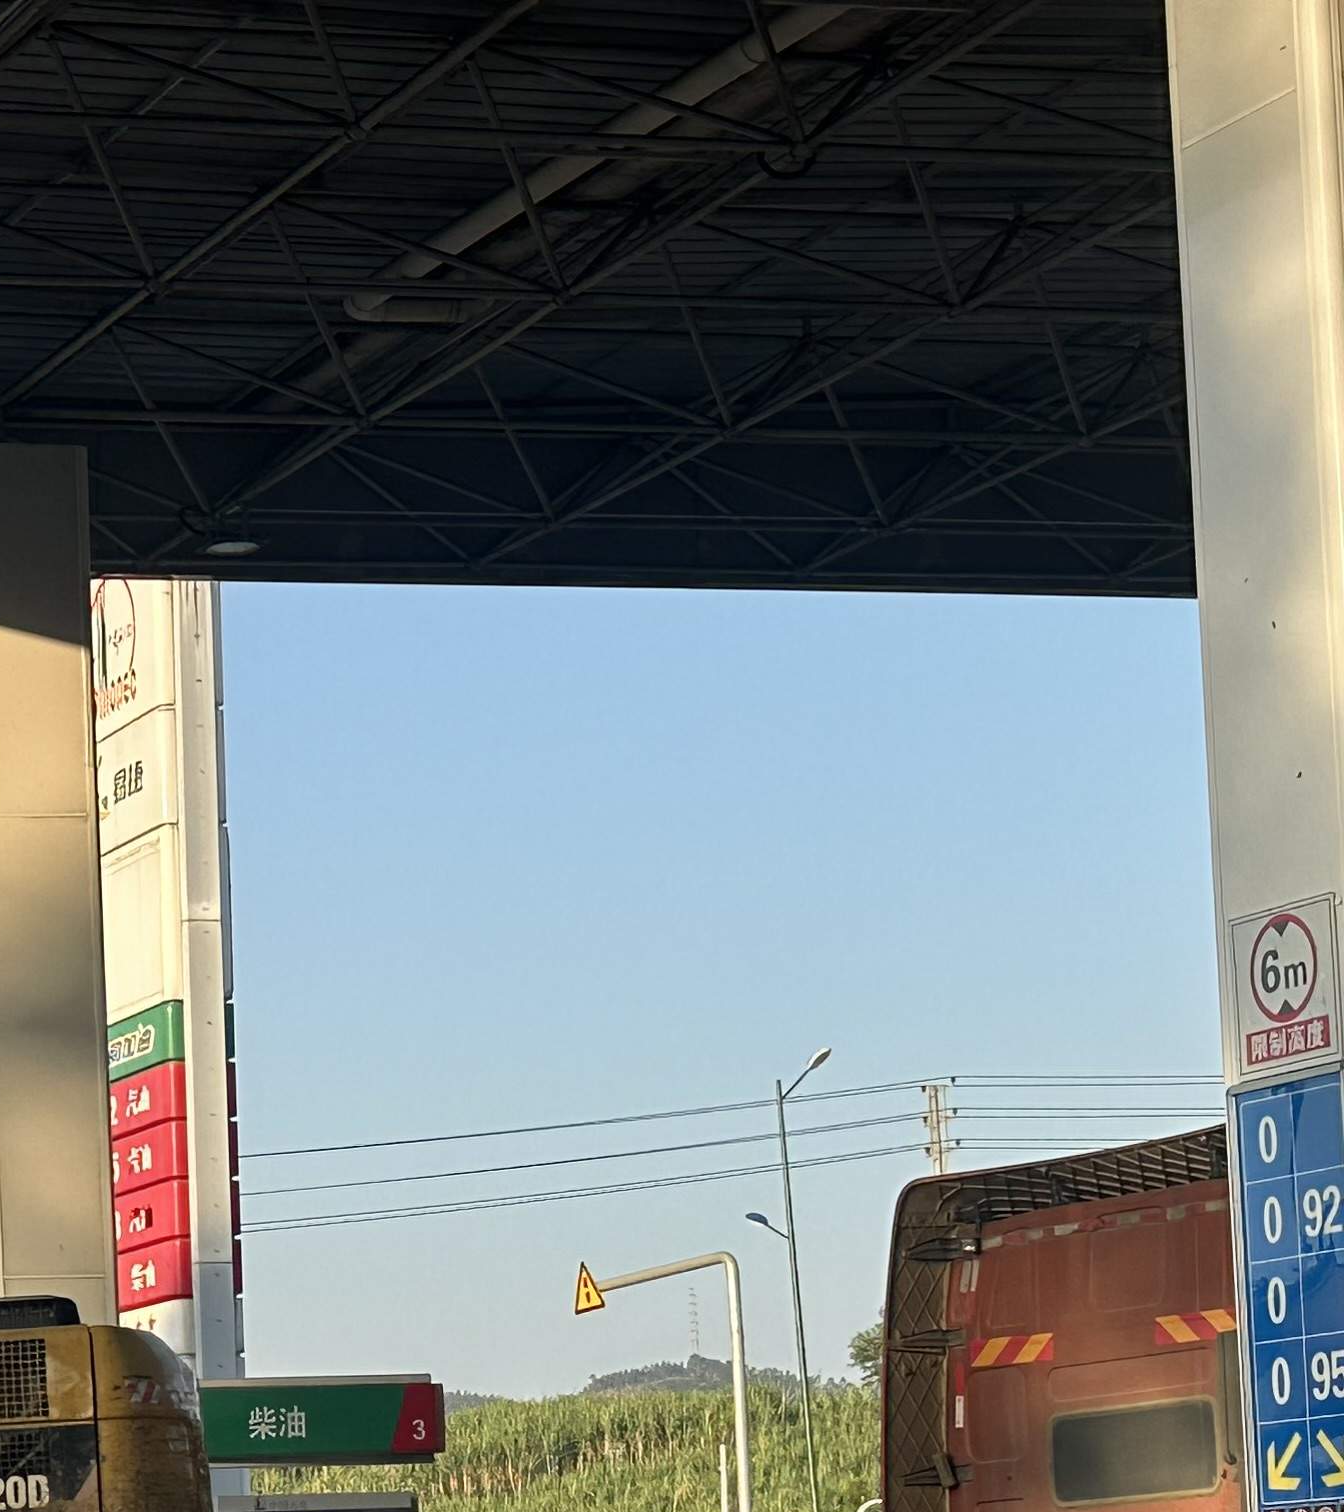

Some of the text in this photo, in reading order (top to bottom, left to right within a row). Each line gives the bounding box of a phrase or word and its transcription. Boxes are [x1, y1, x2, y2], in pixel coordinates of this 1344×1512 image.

[1261, 950, 1307, 994] 6m
[1251, 1021, 1325, 1063] 限制高度
[1258, 1116, 1278, 1164] 0
[1263, 1185, 1343, 1244] 0 92
[1267, 1276, 1287, 1325] 0
[1271, 1349, 1344, 1406] 0 95
[248, 1405, 307, 1440] 柴油
[412, 1419, 426, 1440] 3
